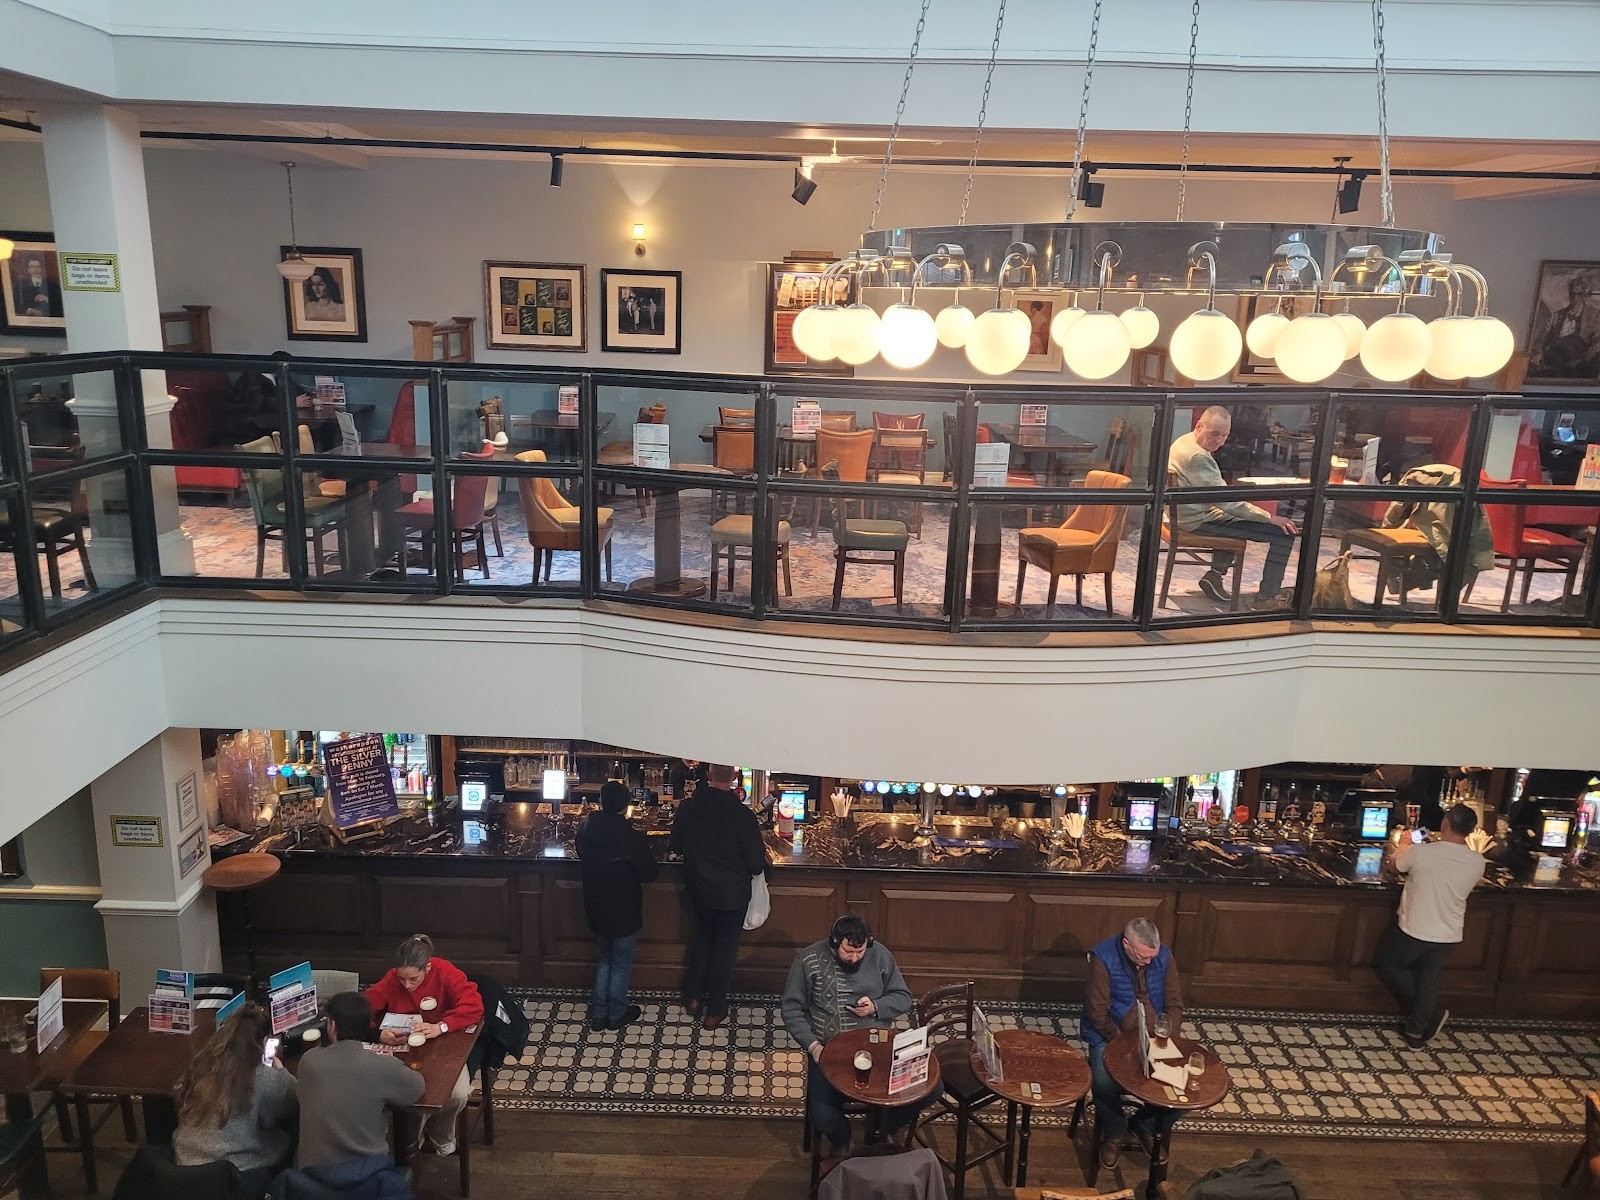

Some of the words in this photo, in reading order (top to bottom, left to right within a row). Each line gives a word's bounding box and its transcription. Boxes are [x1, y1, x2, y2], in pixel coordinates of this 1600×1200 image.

[329, 740, 379, 752] wetherspoon
[330, 756, 349, 766] THE
[351, 749, 381, 762] SILVER
[342, 759, 374, 772] PENNY
